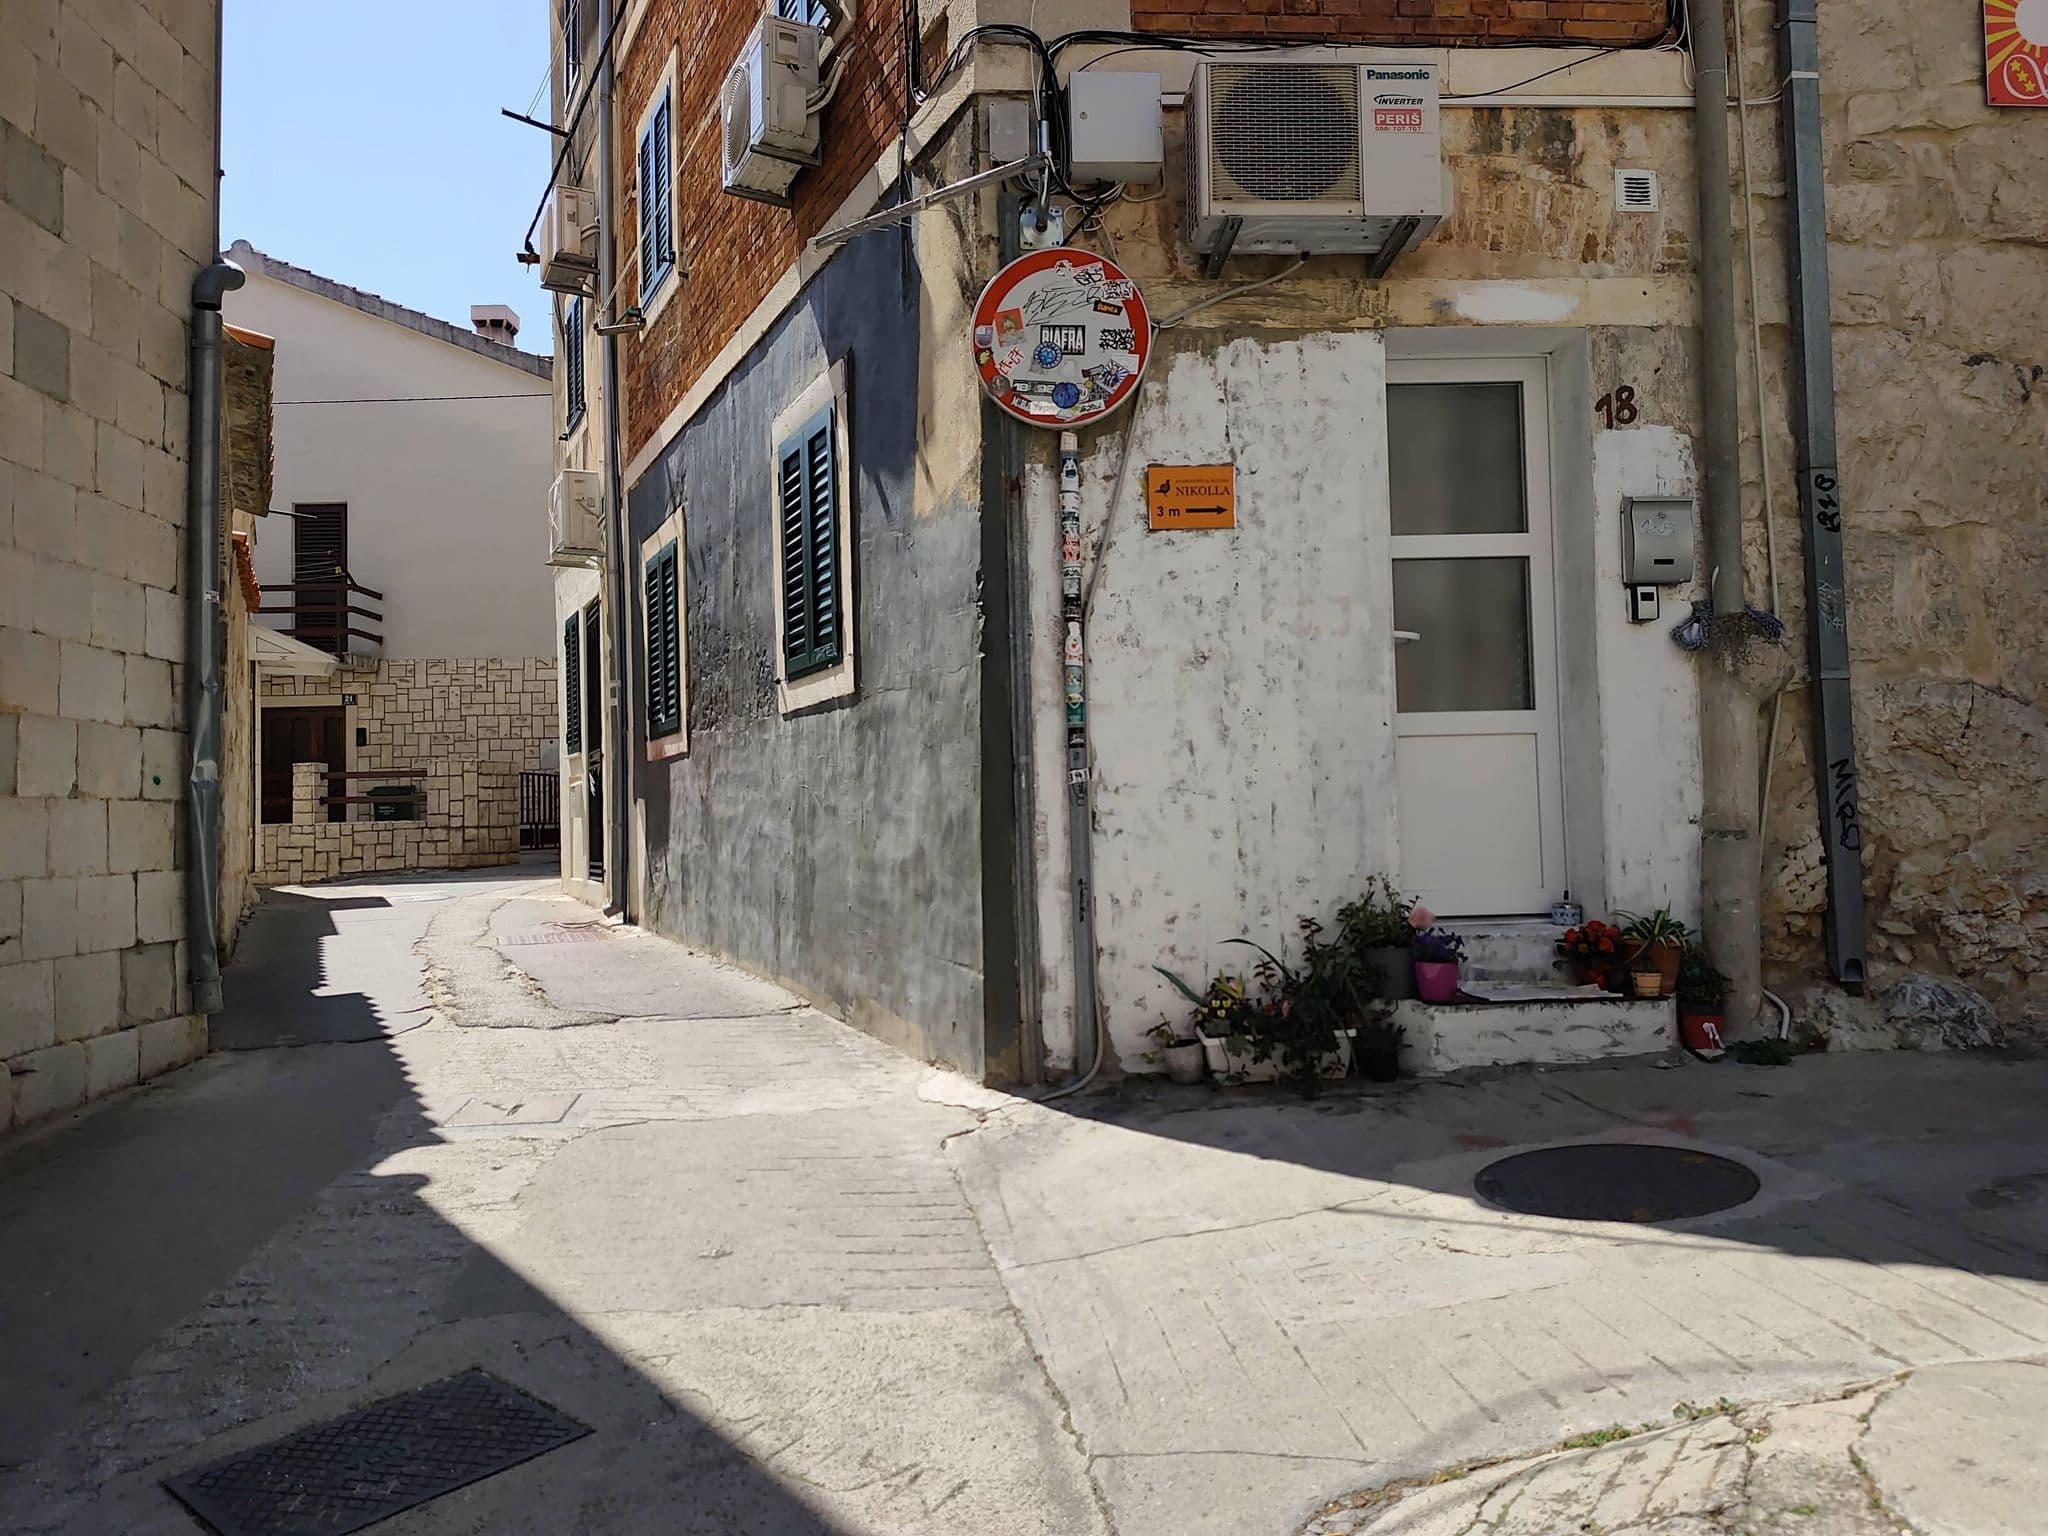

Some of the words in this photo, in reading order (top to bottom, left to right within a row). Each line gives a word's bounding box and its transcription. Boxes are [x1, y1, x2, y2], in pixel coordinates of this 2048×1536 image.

[1366, 69, 1430, 80] Panasonic
[1376, 113, 1420, 124] PERIŠ
[1594, 385, 1638, 430] 18
[1175, 486, 1230, 496] NIKOLLA
[1156, 506, 1164, 517] 3
[1168, 508, 1180, 517] m
